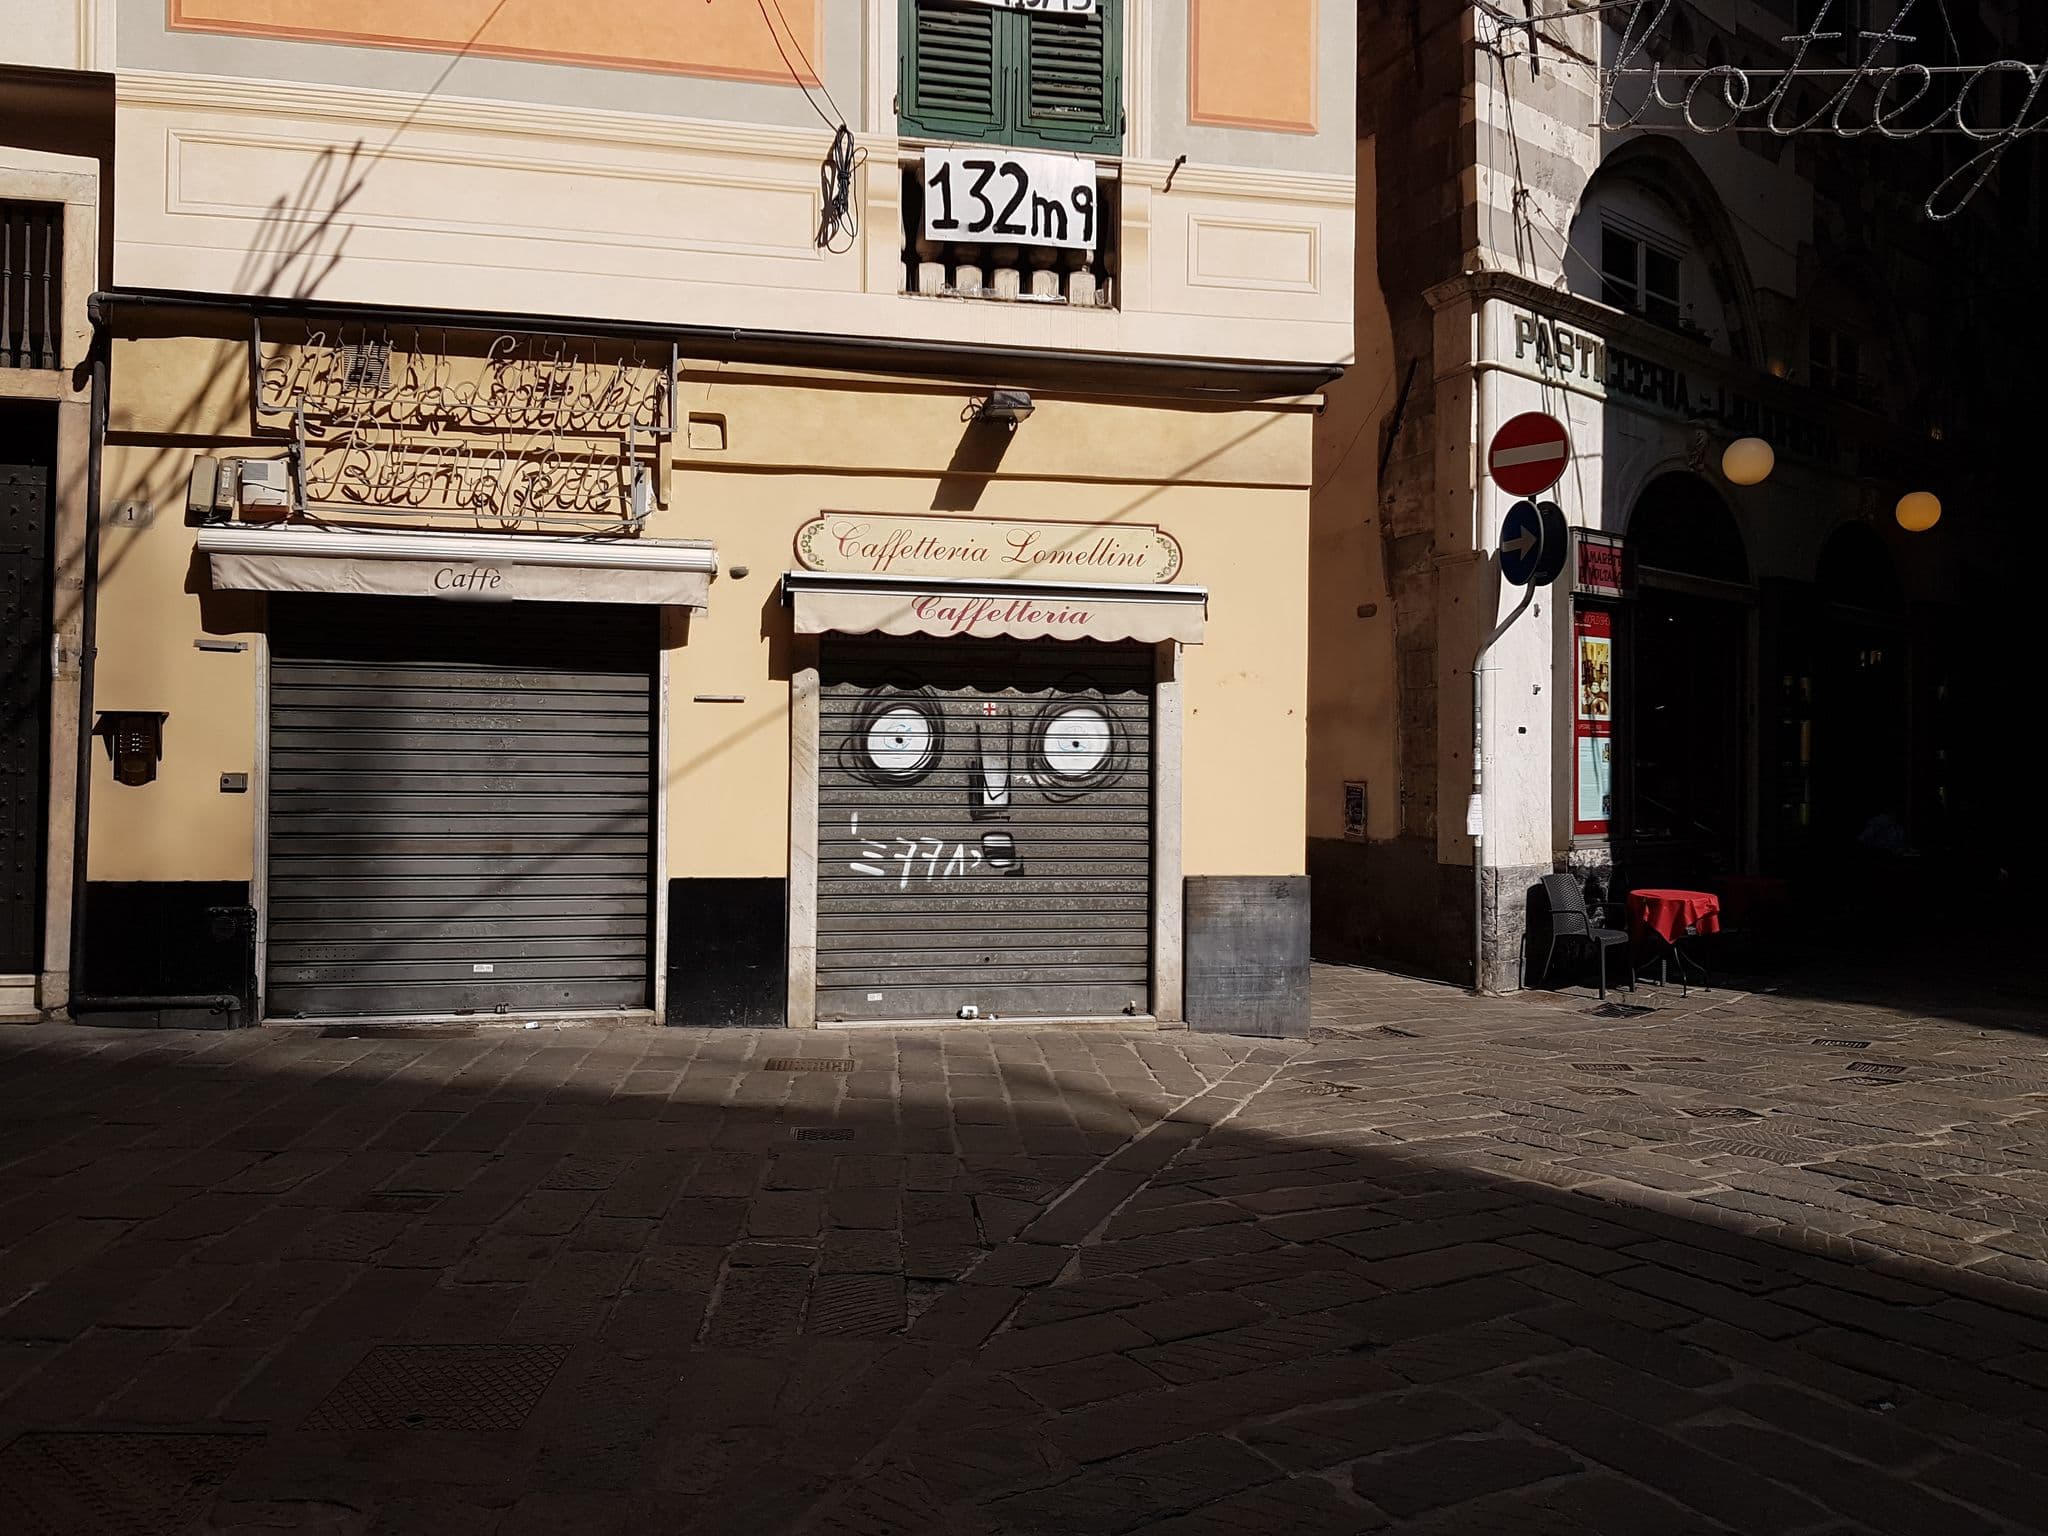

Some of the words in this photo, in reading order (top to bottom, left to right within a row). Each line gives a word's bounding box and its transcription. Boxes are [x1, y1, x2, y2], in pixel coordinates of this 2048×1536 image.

[127, 506, 134, 521] 1
[832, 522, 991, 571] Caffetteria
[1001, 528, 1149, 568] Lomellini
[433, 566, 501, 594] Caffè
[911, 595, 1094, 632] Caffetteria
